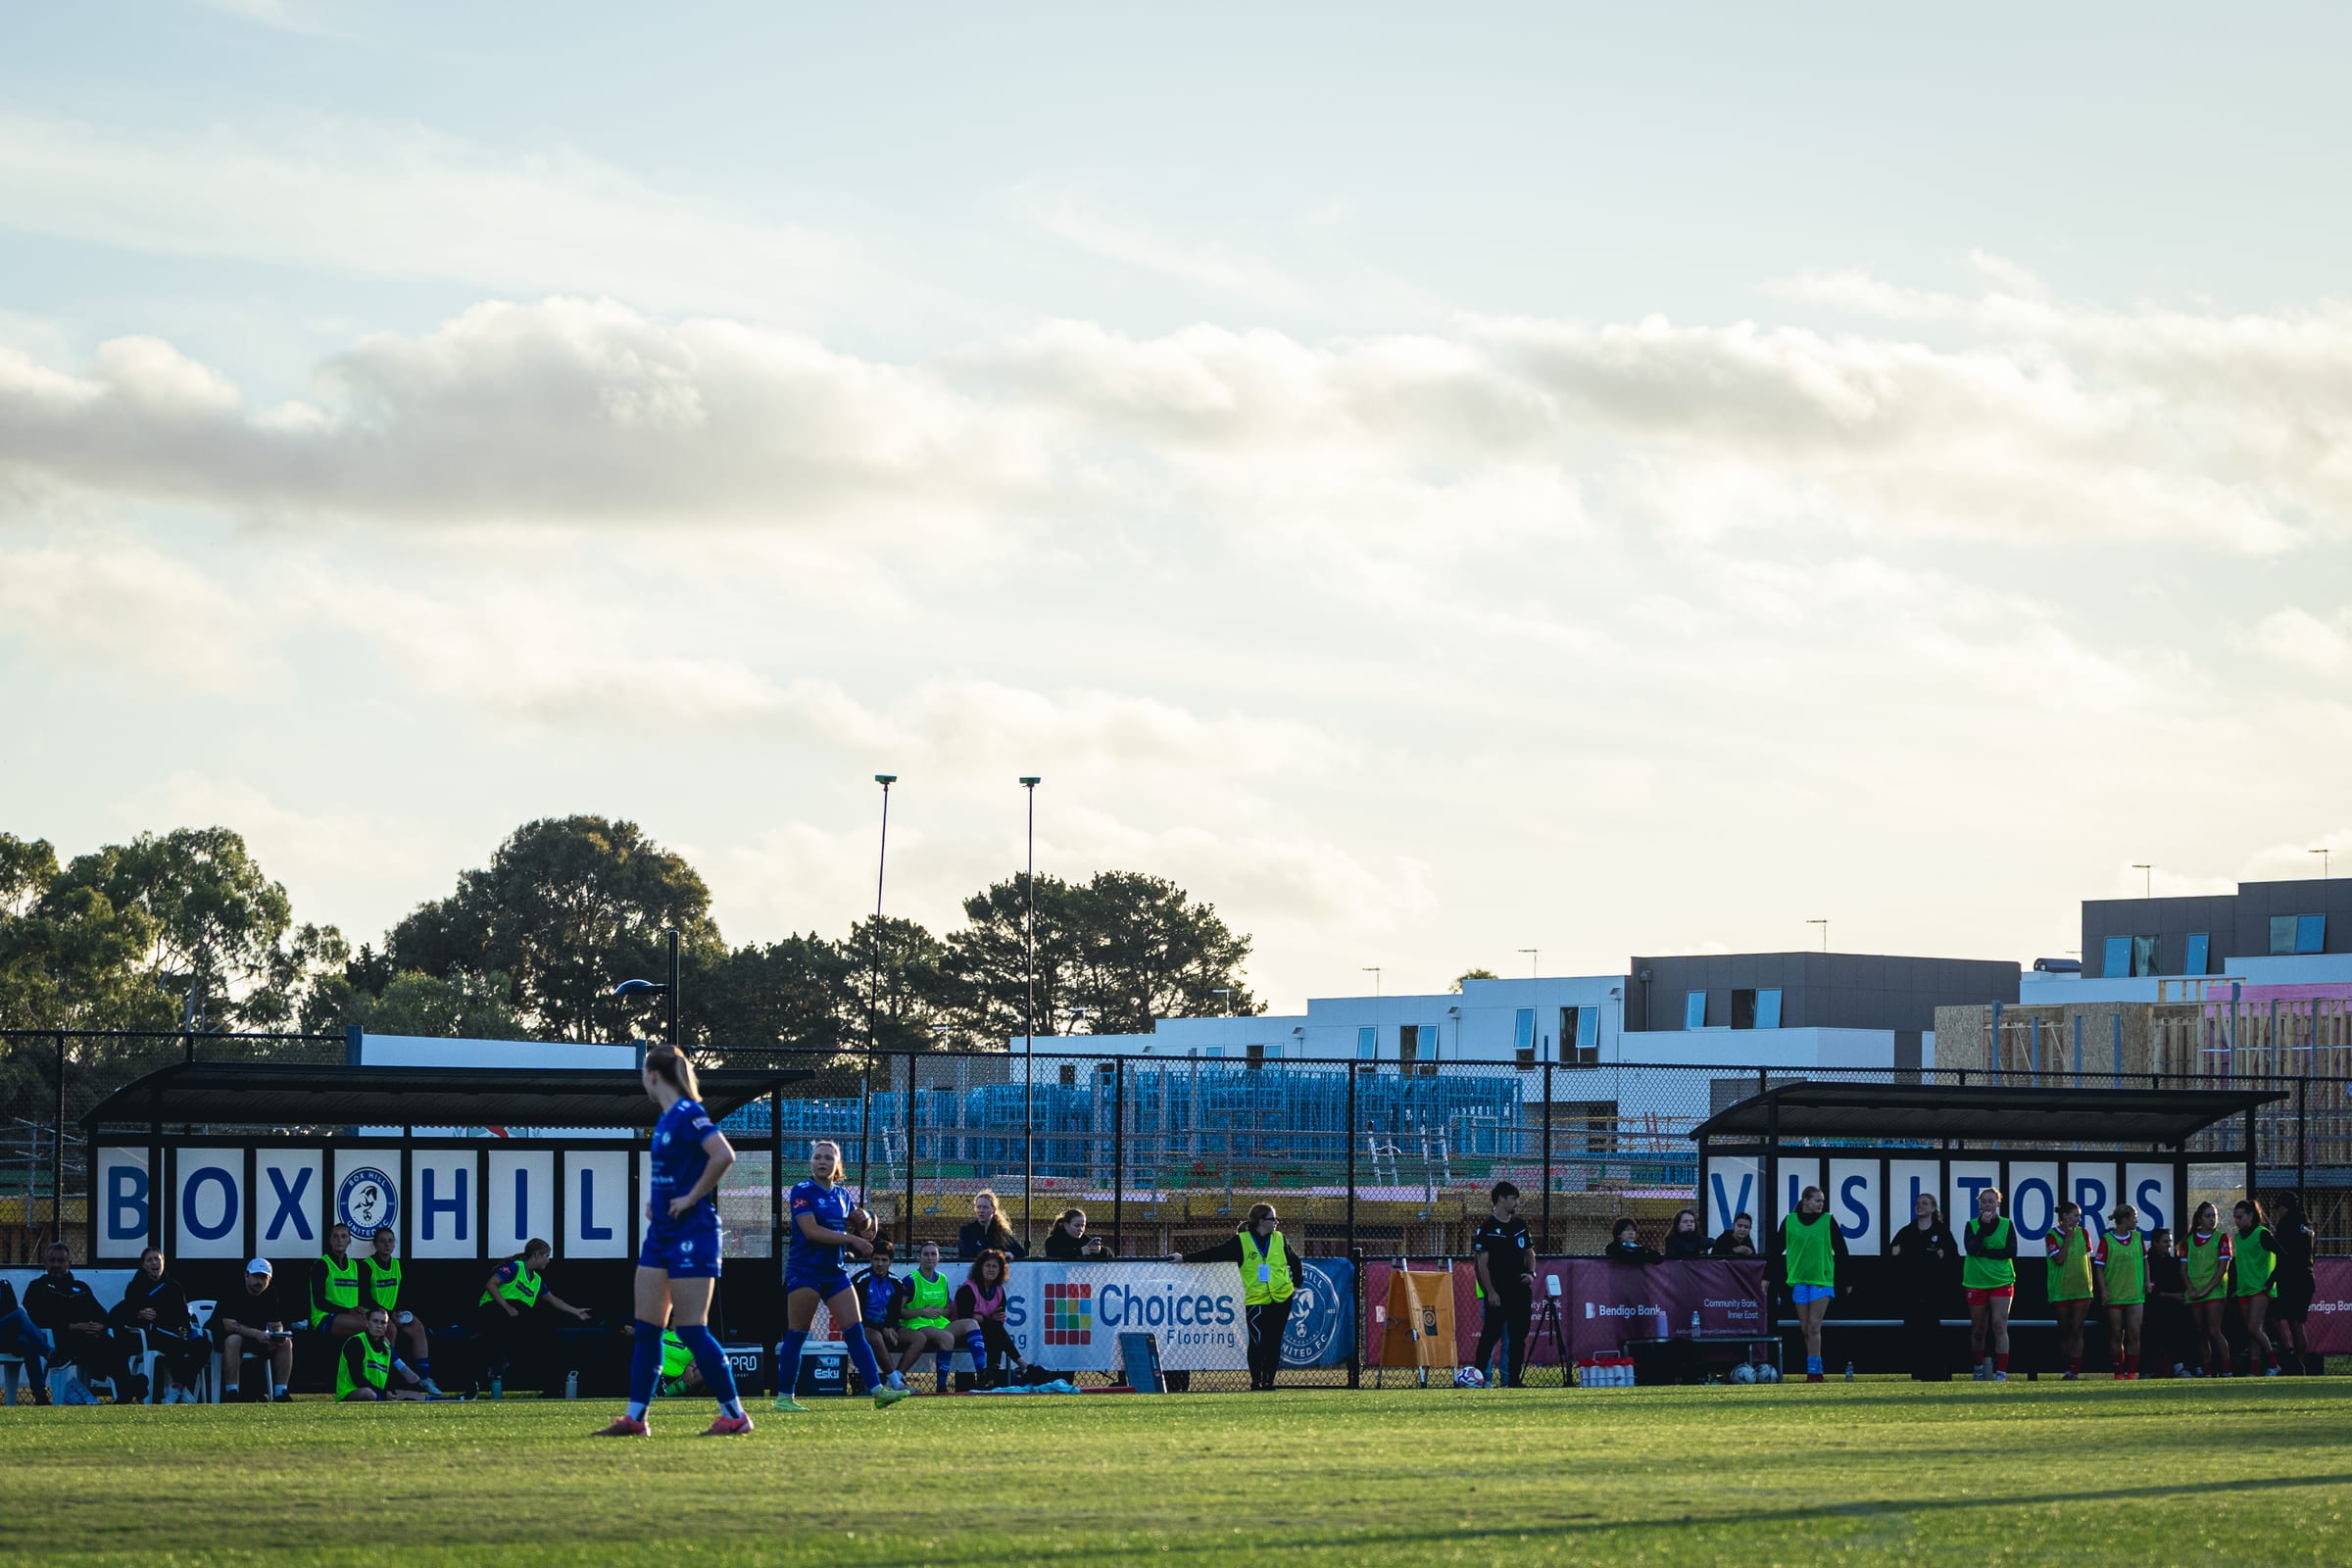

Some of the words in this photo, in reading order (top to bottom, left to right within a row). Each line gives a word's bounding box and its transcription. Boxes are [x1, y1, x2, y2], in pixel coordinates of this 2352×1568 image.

[348, 1172, 366, 1187] BOX
[368, 1171, 387, 1187] HILL
[108, 1165, 315, 1241] BOX
[421, 1168, 613, 1241] HIL
[1710, 1173, 2165, 1243] VISITORS
[1099, 1283, 1235, 1327] Choices
[1599, 1304, 1637, 1319] Bendigo
[1638, 1304, 1661, 1316] Bank
[1703, 1298, 1740, 1309] Community
[1741, 1298, 1758, 1308] Bank
[2308, 1299, 2336, 1314] ndigo
[2337, 1299, 2352, 1311] Ban
[1728, 1310, 1743, 1319] Inner
[1744, 1310, 1759, 1319] East
[1166, 1329, 1235, 1348] Flooring
[1281, 1343, 1313, 1357] NITED
[1315, 1334, 1327, 1349] FC
[730, 1355, 757, 1371] PRO
[814, 1368, 840, 1379] Esky
